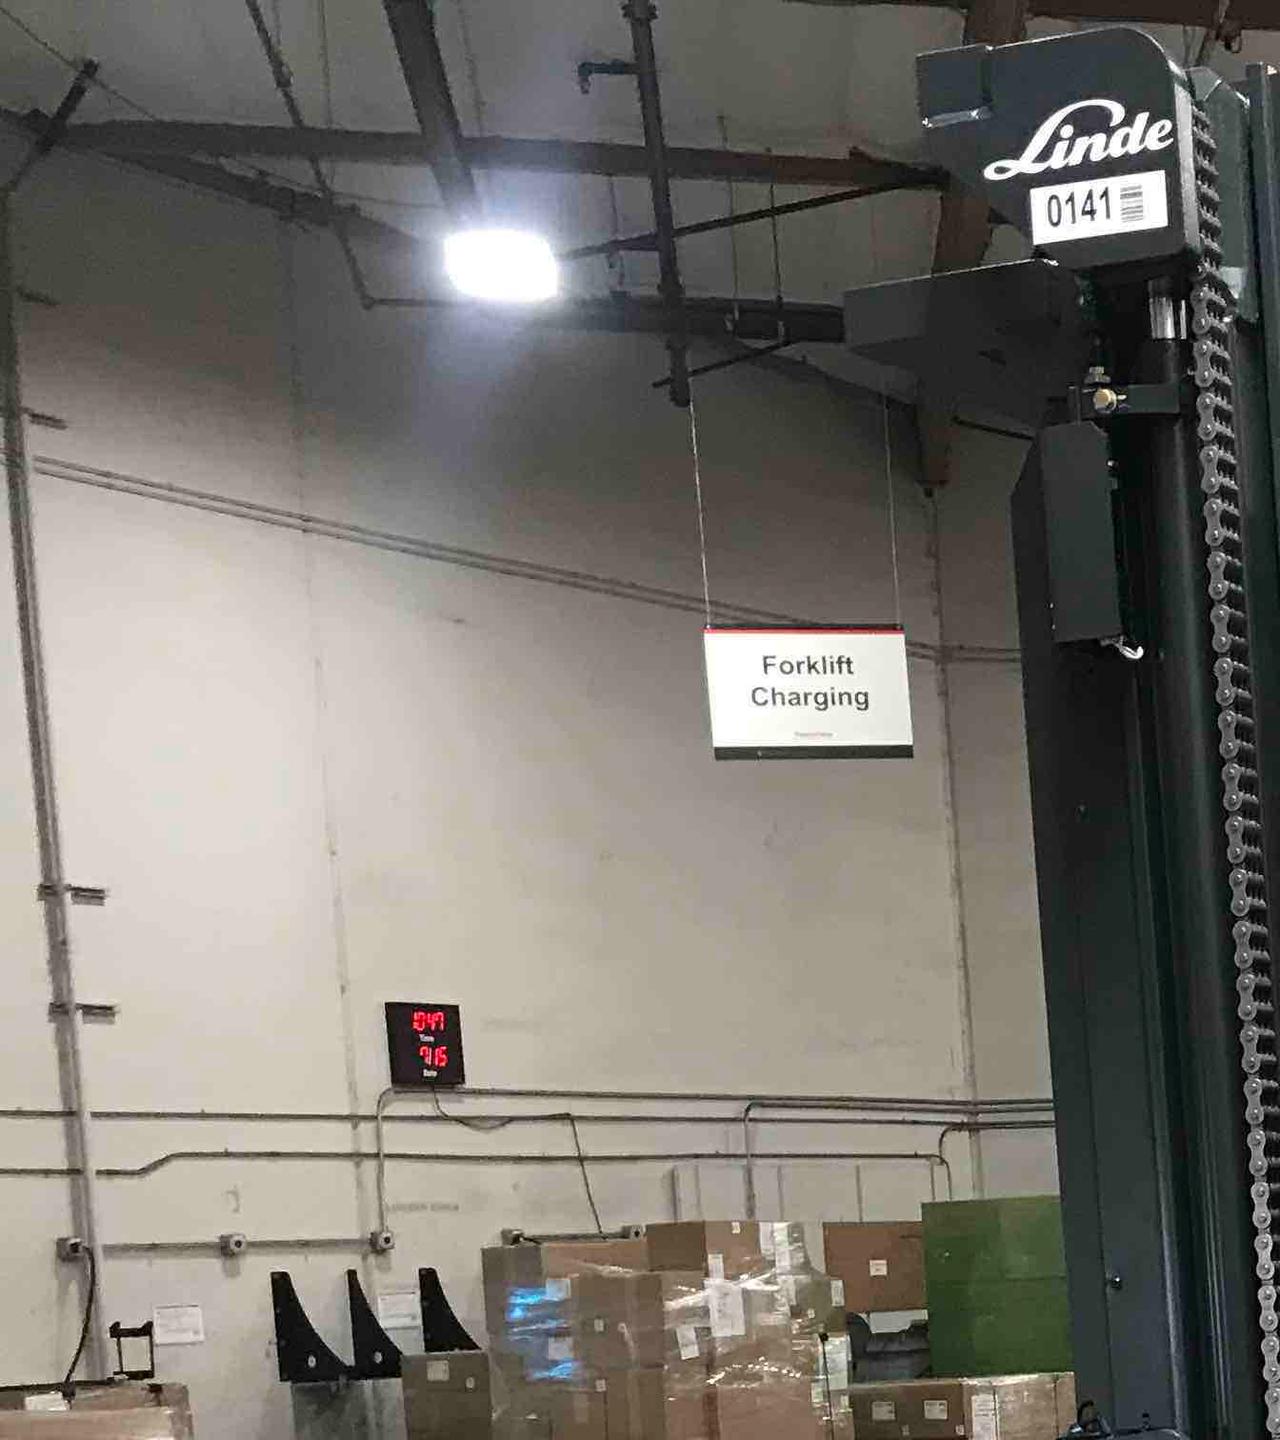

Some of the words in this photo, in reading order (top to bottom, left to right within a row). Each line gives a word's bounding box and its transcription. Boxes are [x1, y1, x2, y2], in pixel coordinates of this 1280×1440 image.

[983, 98, 1174, 181] Linde
[1047, 186, 1112, 229] 0141
[762, 655, 854, 675] Forklift
[751, 686, 870, 711] Charging
